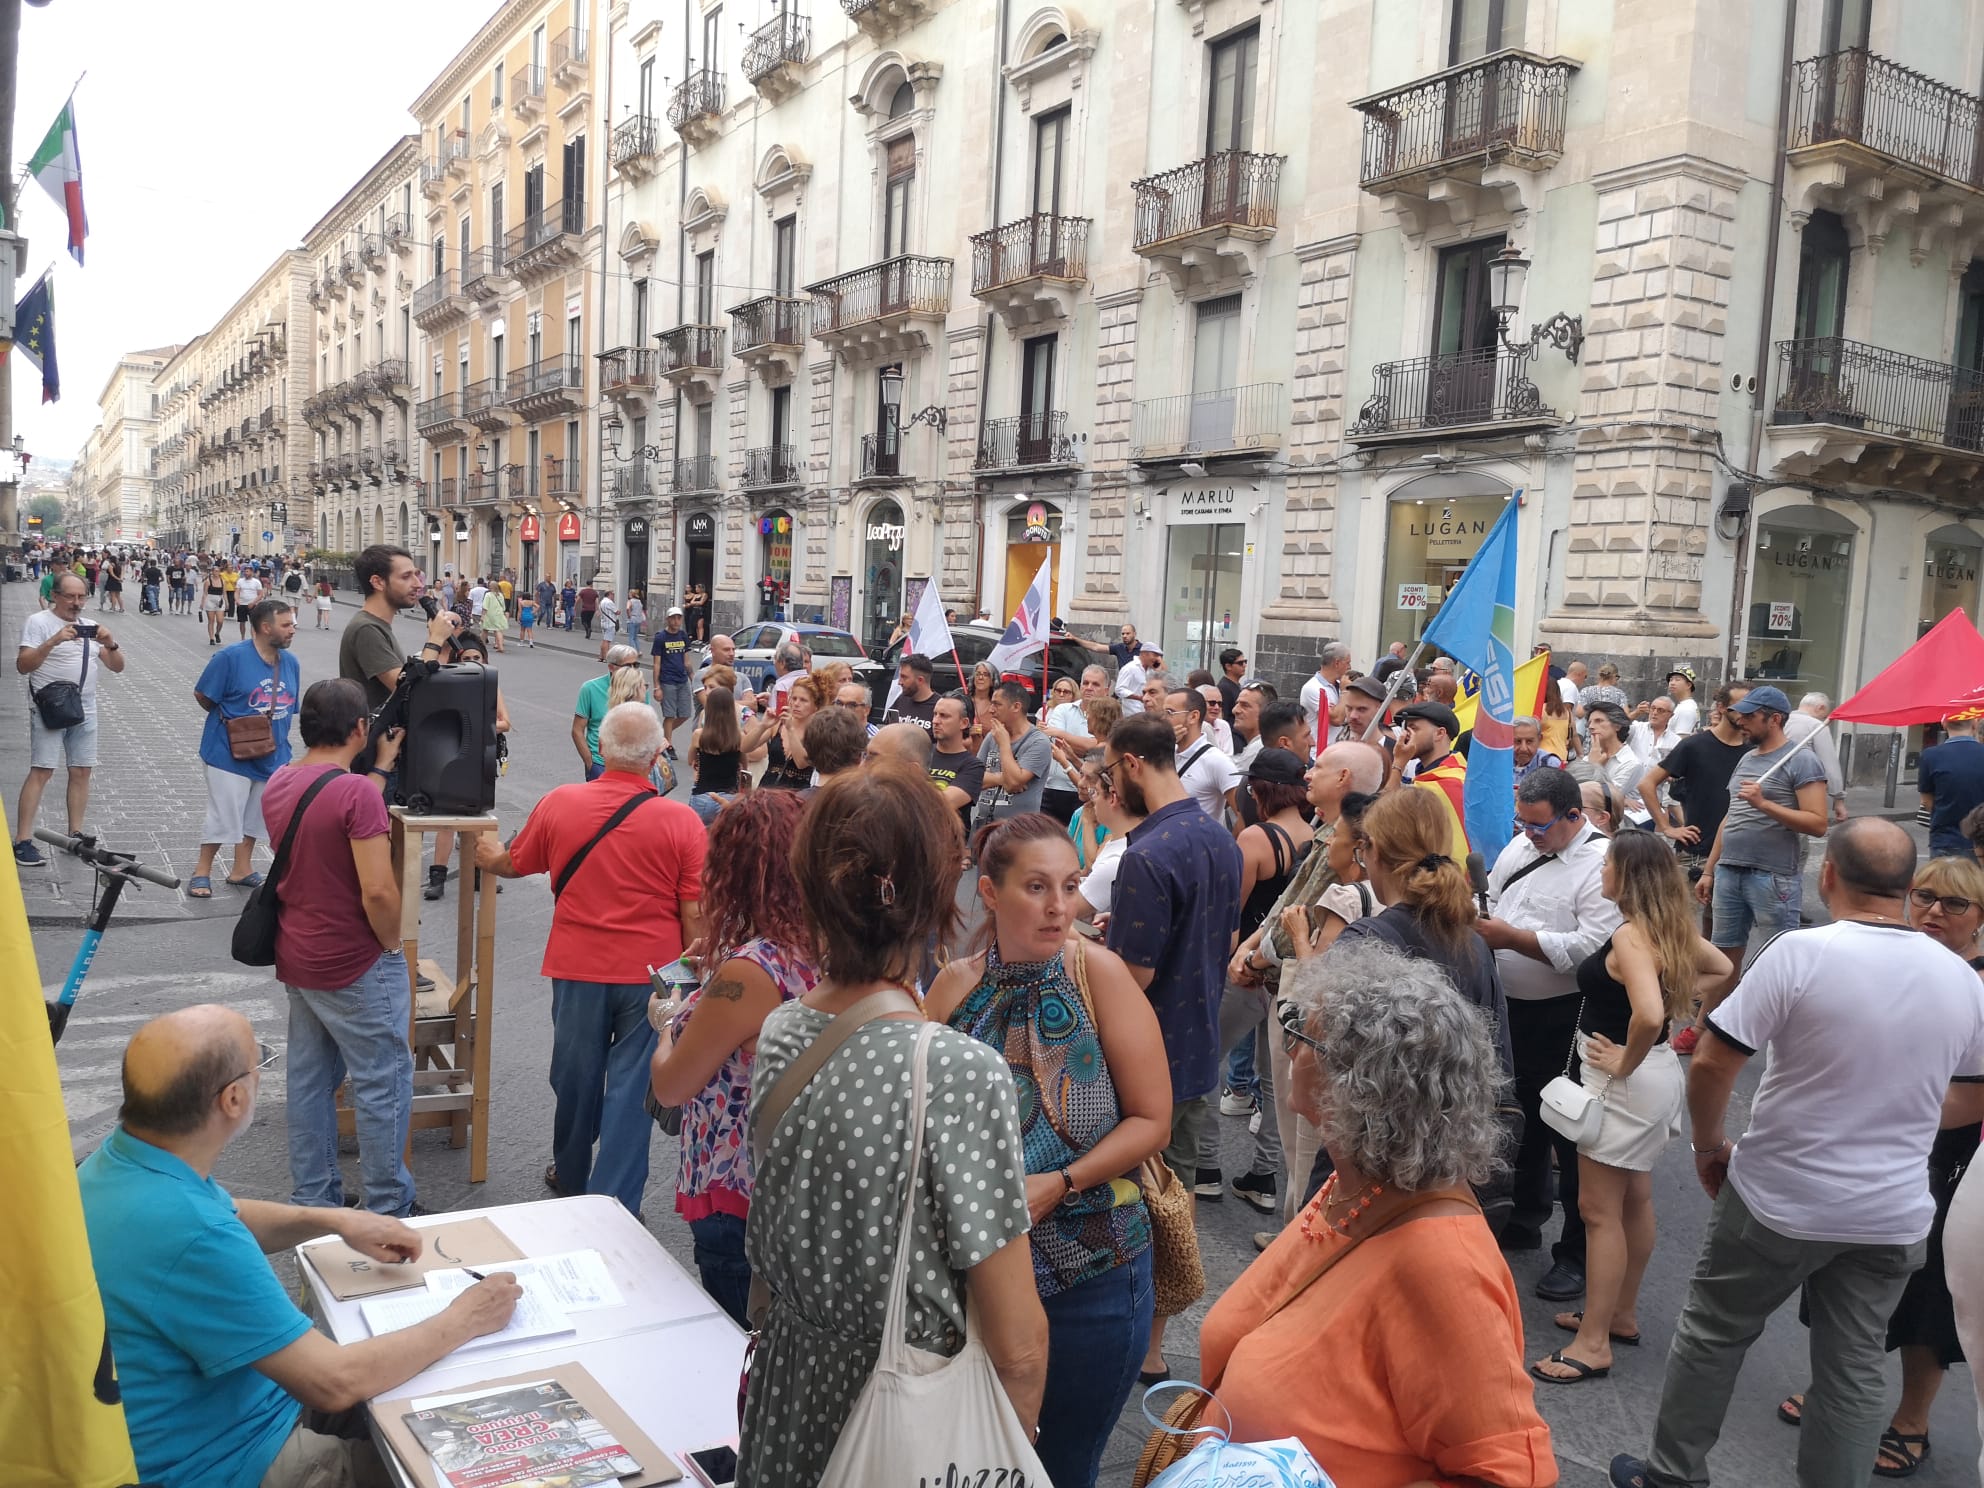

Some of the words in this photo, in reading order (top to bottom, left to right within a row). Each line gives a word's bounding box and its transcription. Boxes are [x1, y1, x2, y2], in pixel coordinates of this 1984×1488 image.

[1181, 486, 1234, 504] MARLÙ
[692, 519, 708, 530] NYX
[1410, 521, 1485, 536] LUGAN
[1775, 551, 1832, 571] LUGAN
[1926, 564, 1975, 582] LUGAN
[1400, 595, 1426, 607] 70%
[1770, 613, 1792, 627] 70%
[466, 1414, 526, 1433] FUTURO
[472, 1420, 551, 1446] CREA
[484, 1435, 545, 1454] LAVORO
